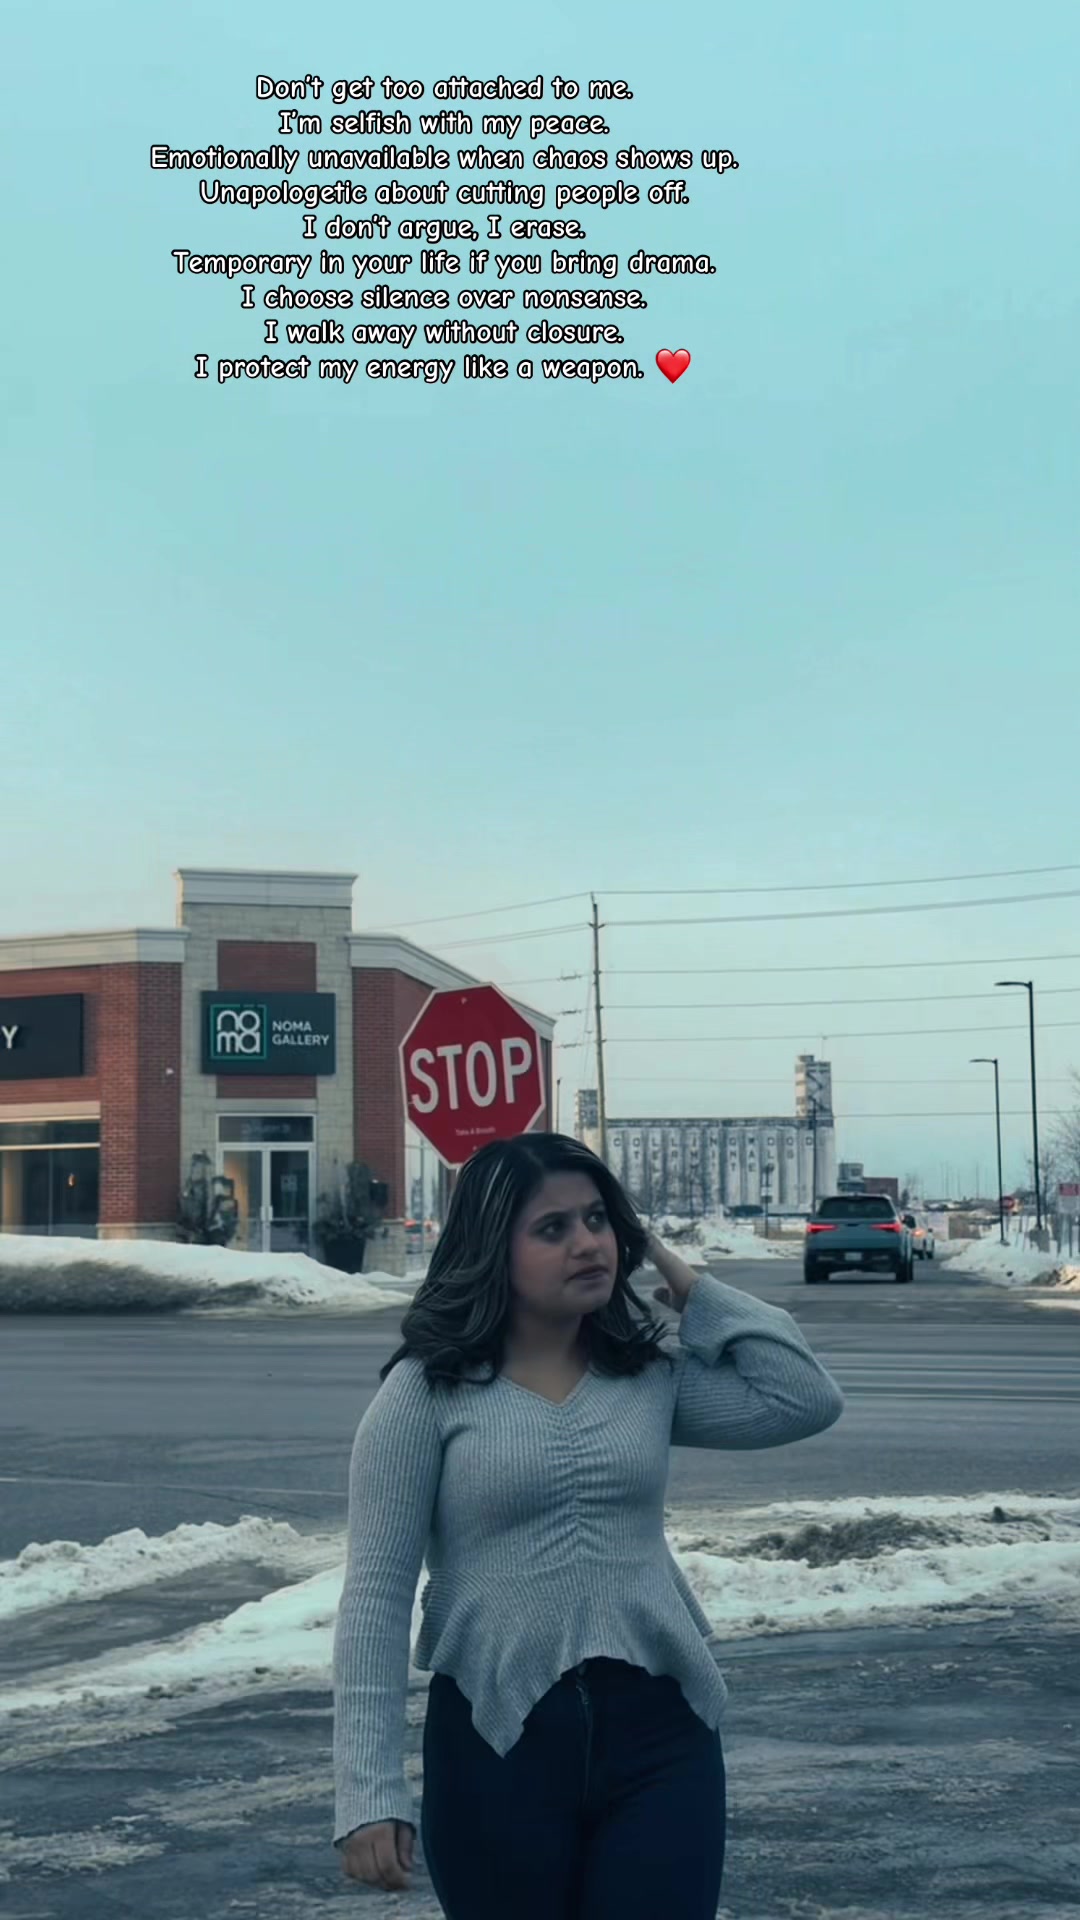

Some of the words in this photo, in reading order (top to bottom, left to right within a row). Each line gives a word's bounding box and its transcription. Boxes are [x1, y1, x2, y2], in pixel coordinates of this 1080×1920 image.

[271, 1020, 312, 1032] NOMA
[271, 1034, 329, 1046] GALLERY
[410, 1036, 532, 1114] STOP
